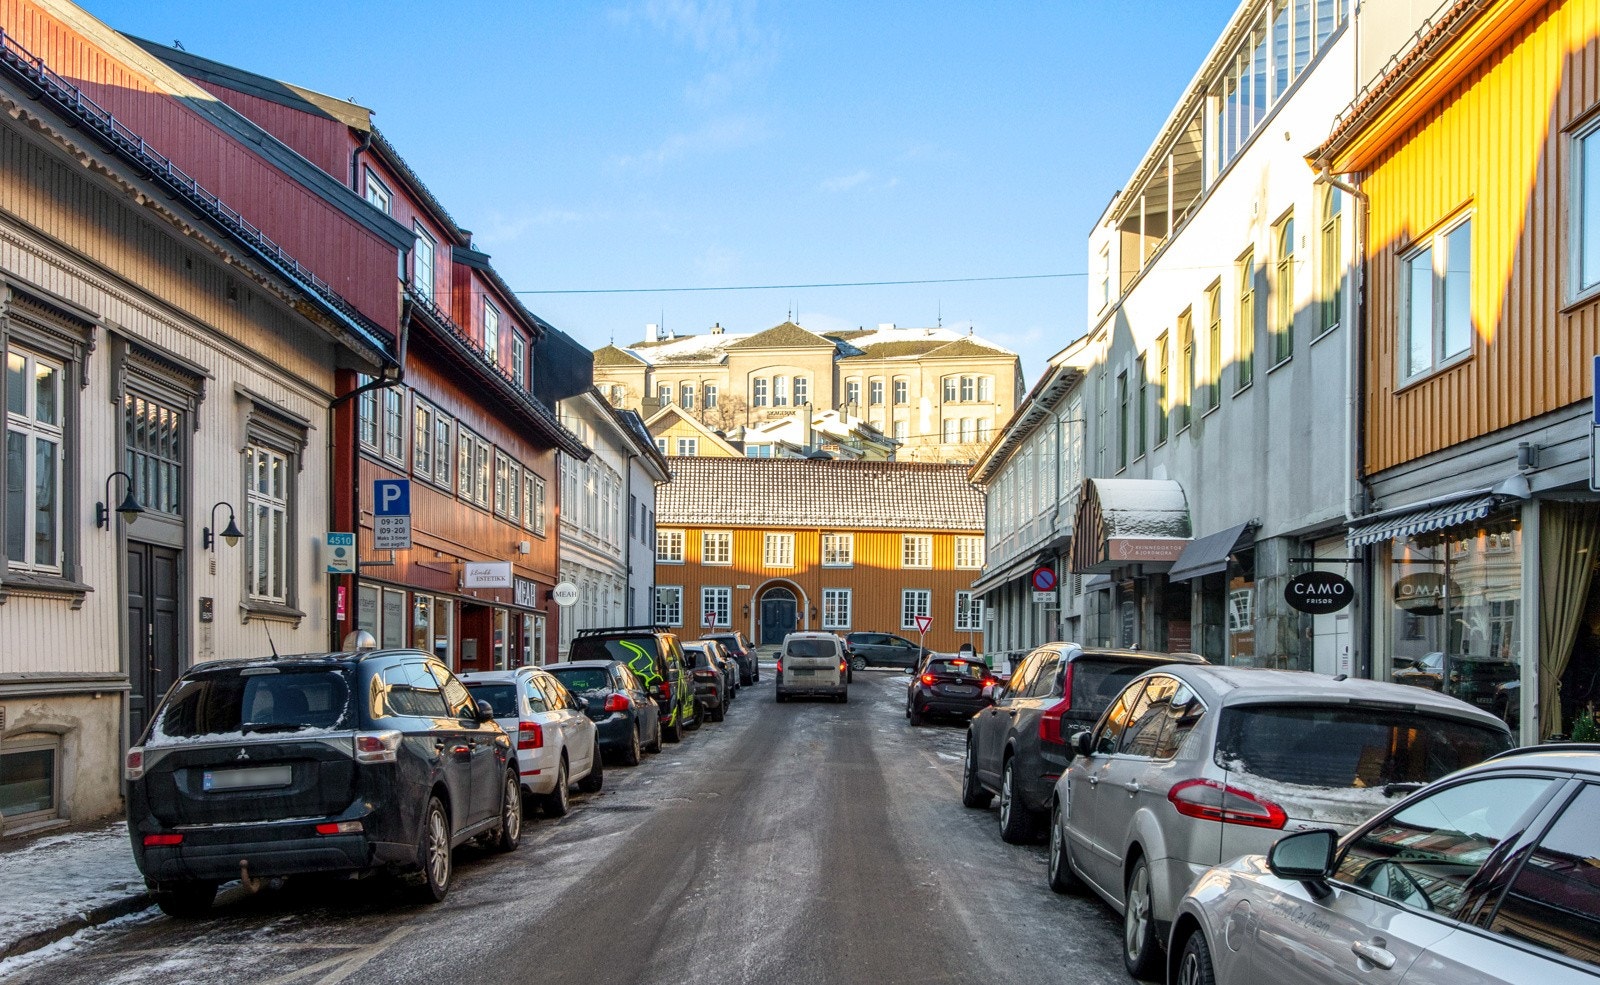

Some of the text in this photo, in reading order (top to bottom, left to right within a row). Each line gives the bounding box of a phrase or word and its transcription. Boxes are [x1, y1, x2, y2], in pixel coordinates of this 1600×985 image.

[382, 484, 402, 511] P
[329, 536, 352, 545] 4510
[514, 578, 536, 608] MEAH
[555, 590, 577, 598] MEAH
[1293, 583, 1346, 595] CAMO
